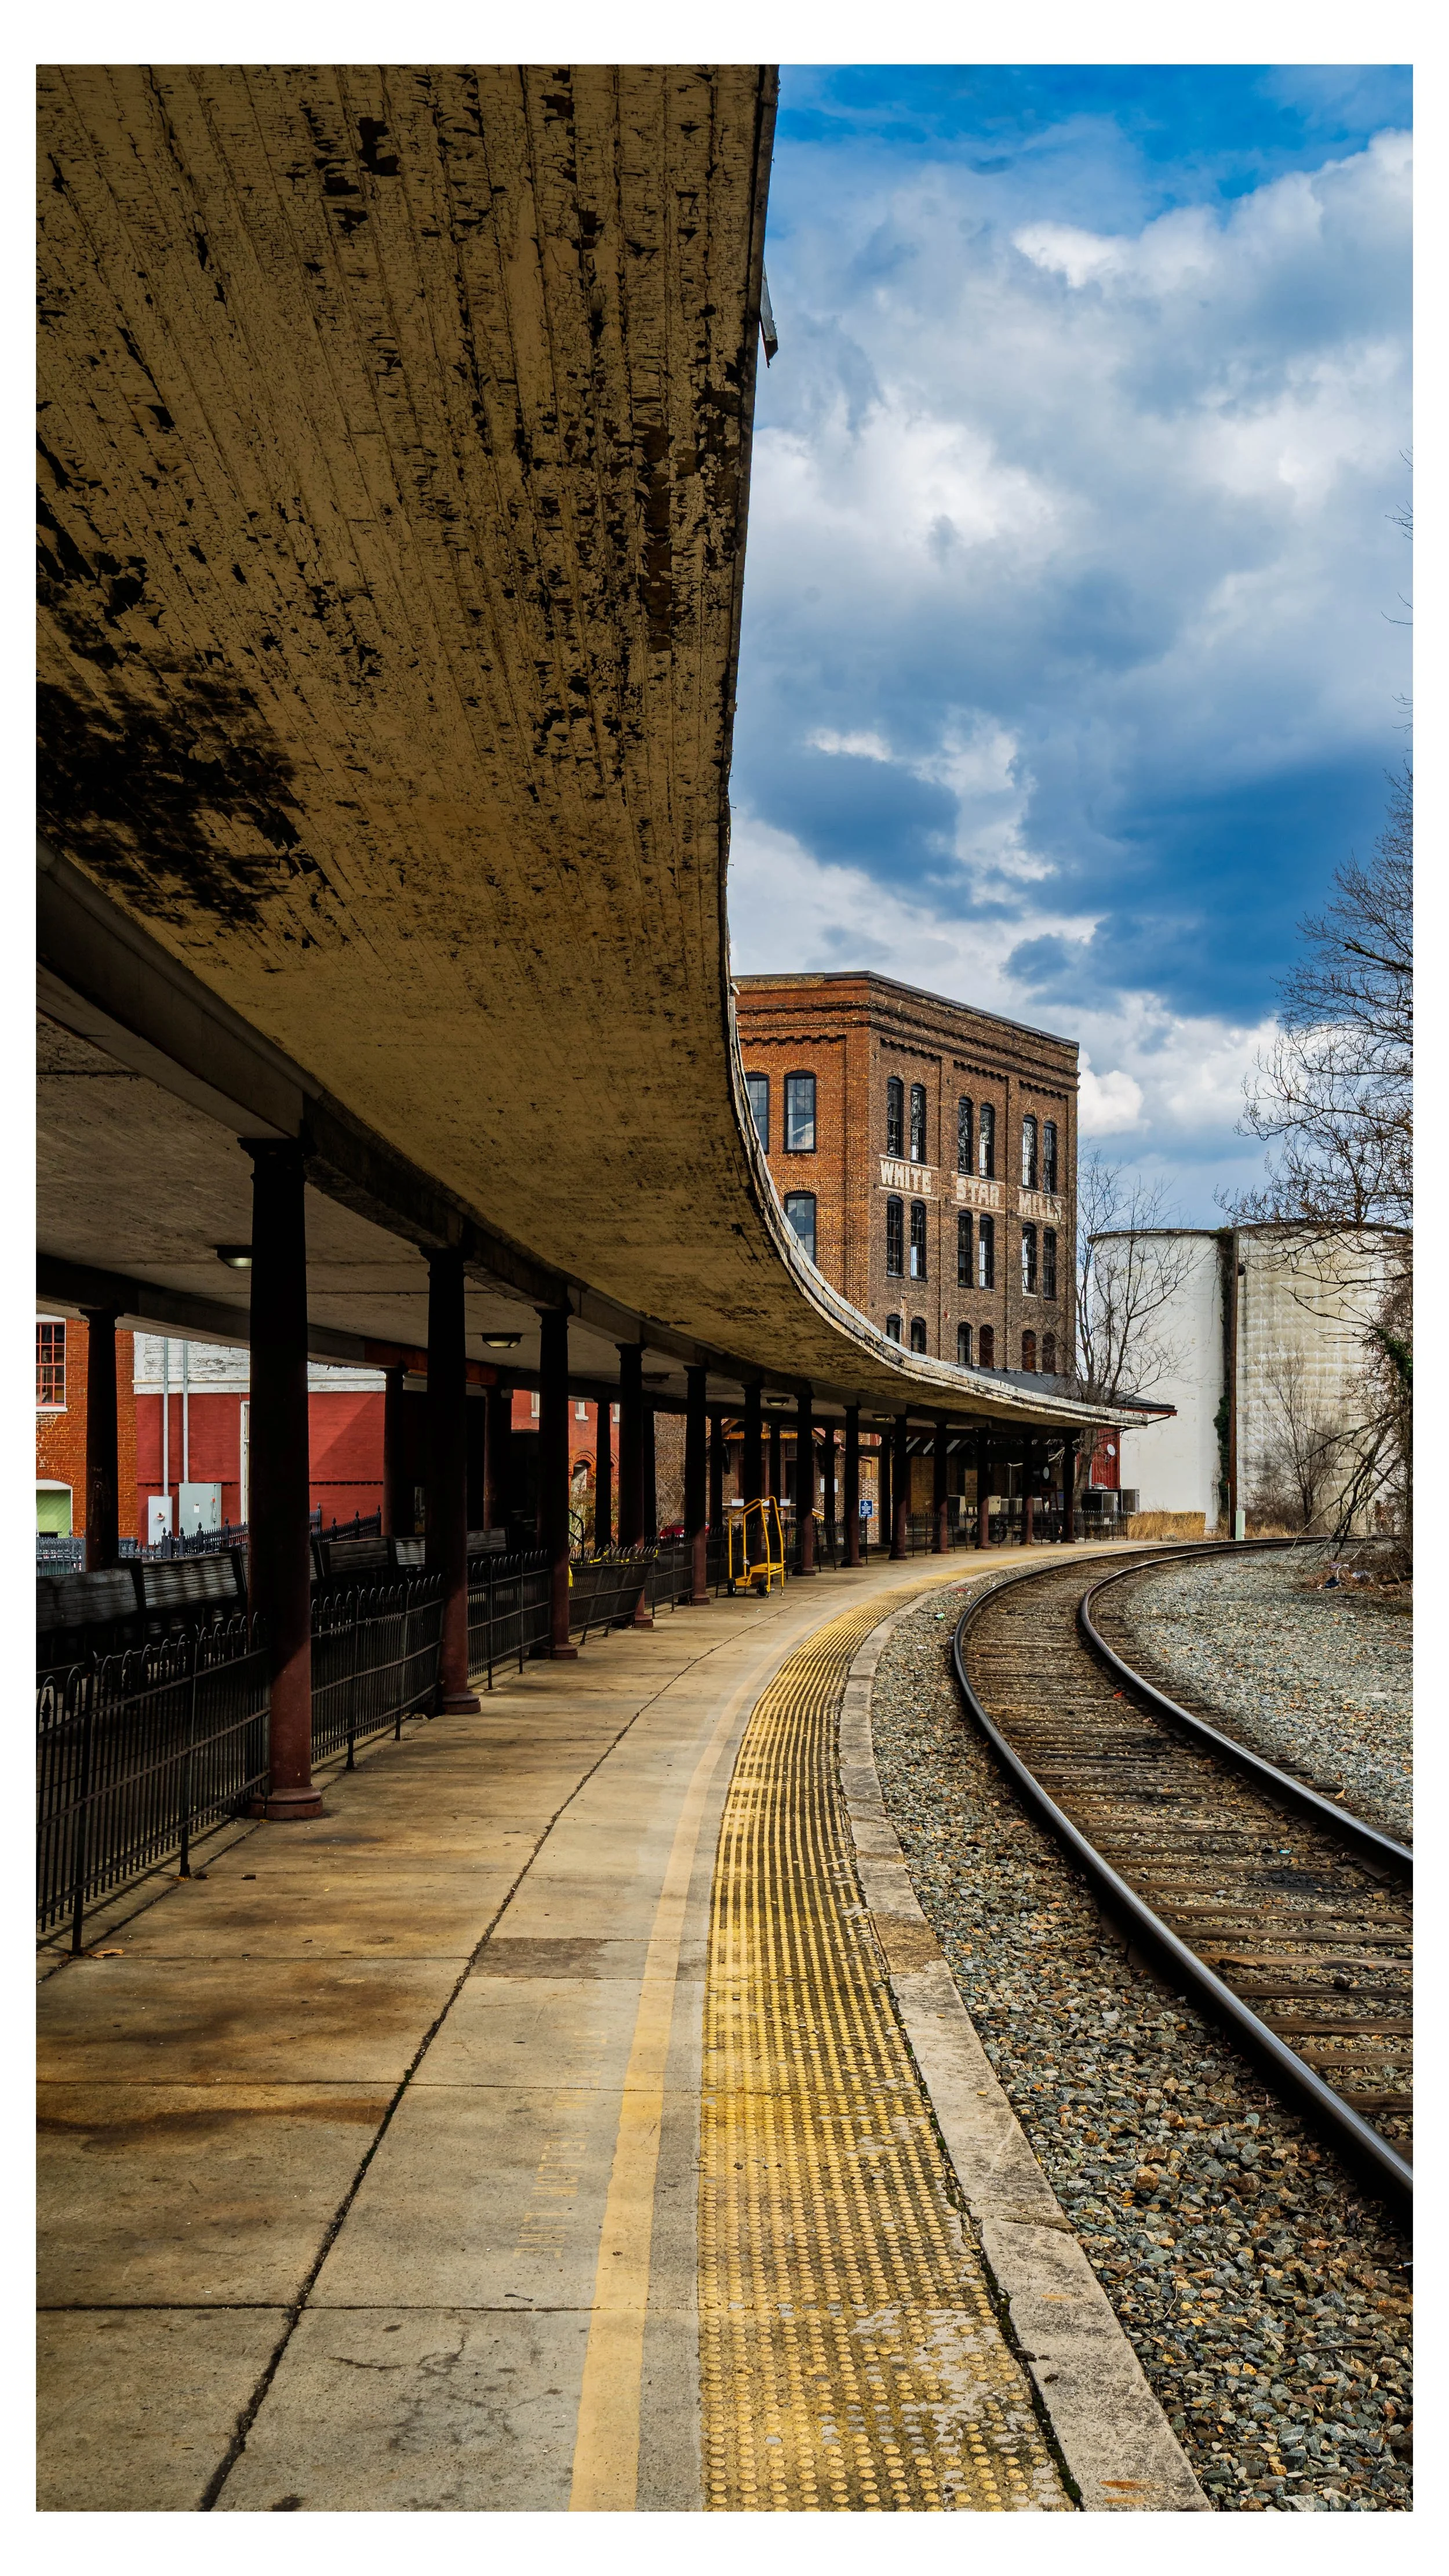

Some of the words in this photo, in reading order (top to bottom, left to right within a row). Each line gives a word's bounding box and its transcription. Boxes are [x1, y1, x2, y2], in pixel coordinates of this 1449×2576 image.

[880, 1160, 931, 1193] WHITE
[956, 1178, 1000, 1207] STAR
[1018, 1191, 1062, 1220] MILLS
[531, 2132, 589, 2197] YELLOW
[513, 2212, 571, 2258] LINE
